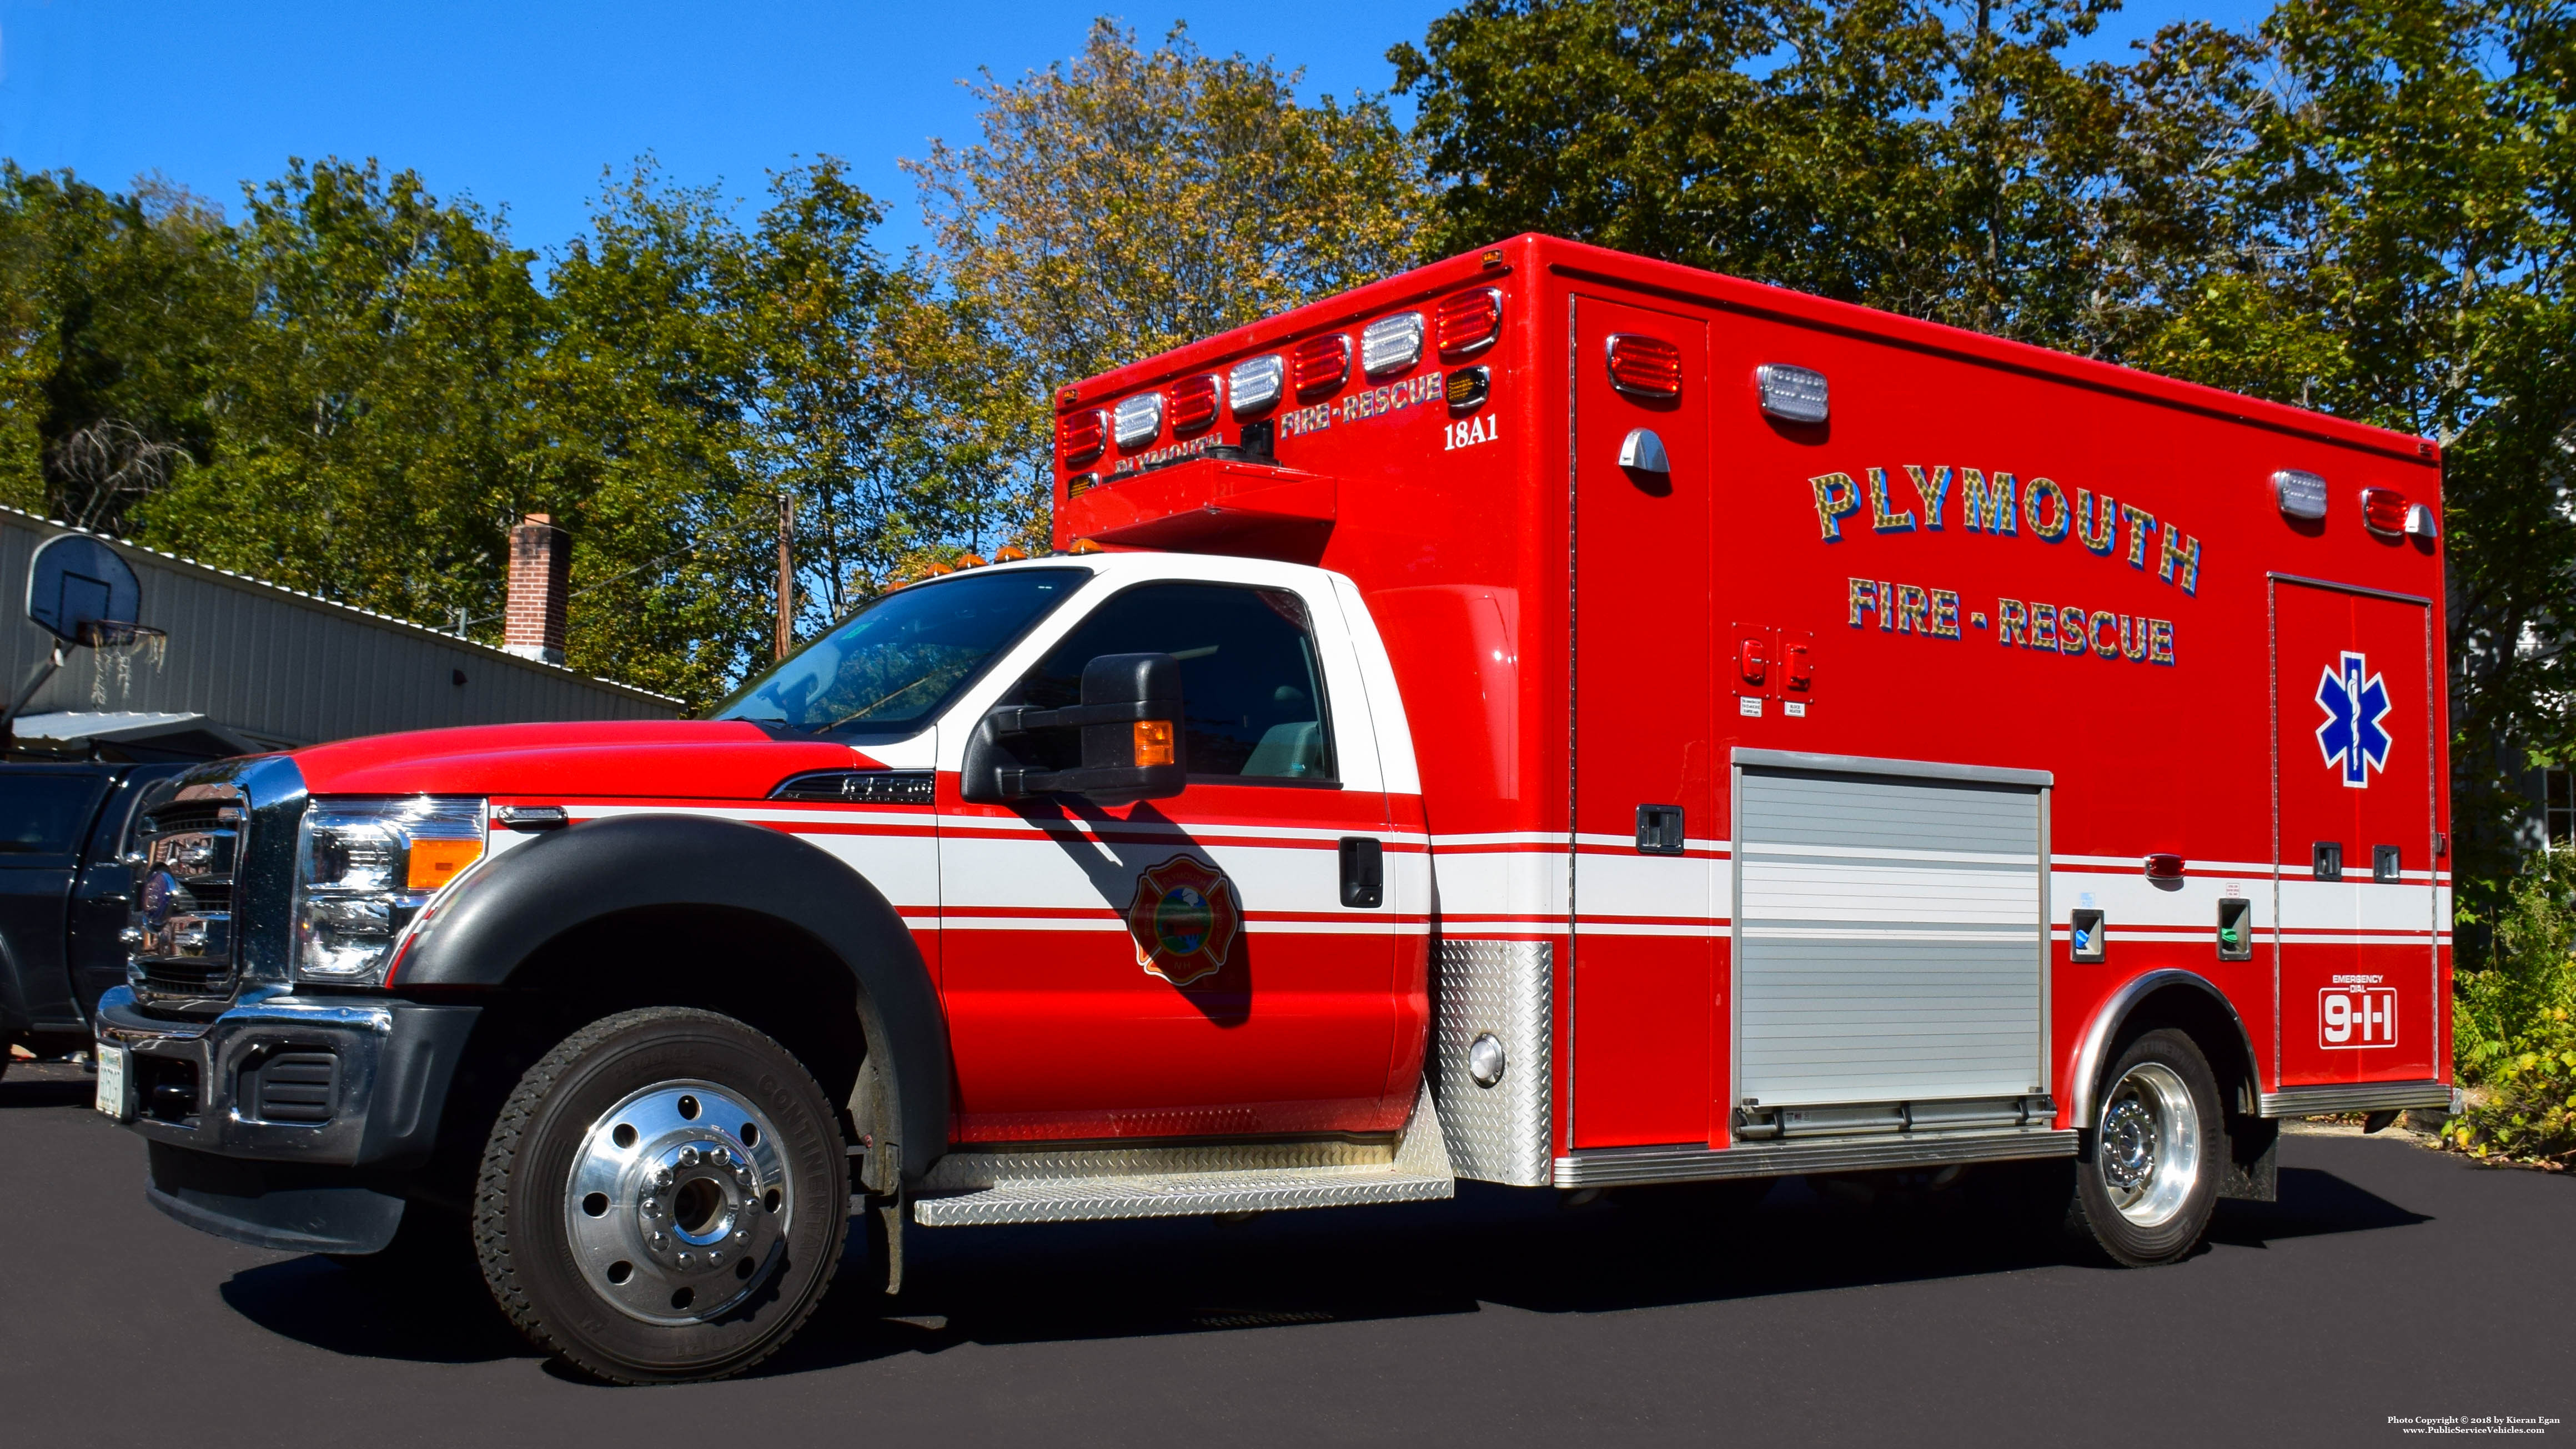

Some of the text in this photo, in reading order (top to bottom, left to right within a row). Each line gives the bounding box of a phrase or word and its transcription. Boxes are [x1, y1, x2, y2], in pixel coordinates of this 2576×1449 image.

[1444, 413, 1498, 451] 18A1
[1808, 464, 2201, 598] PLYMOUTH
[1163, 871, 1206, 886] PLYMOUTH
[2332, 975, 2383, 984] EMERGENCY
[2349, 984, 2366, 993] DIAL
[758, 1074, 828, 1265] CONTINENTAL
